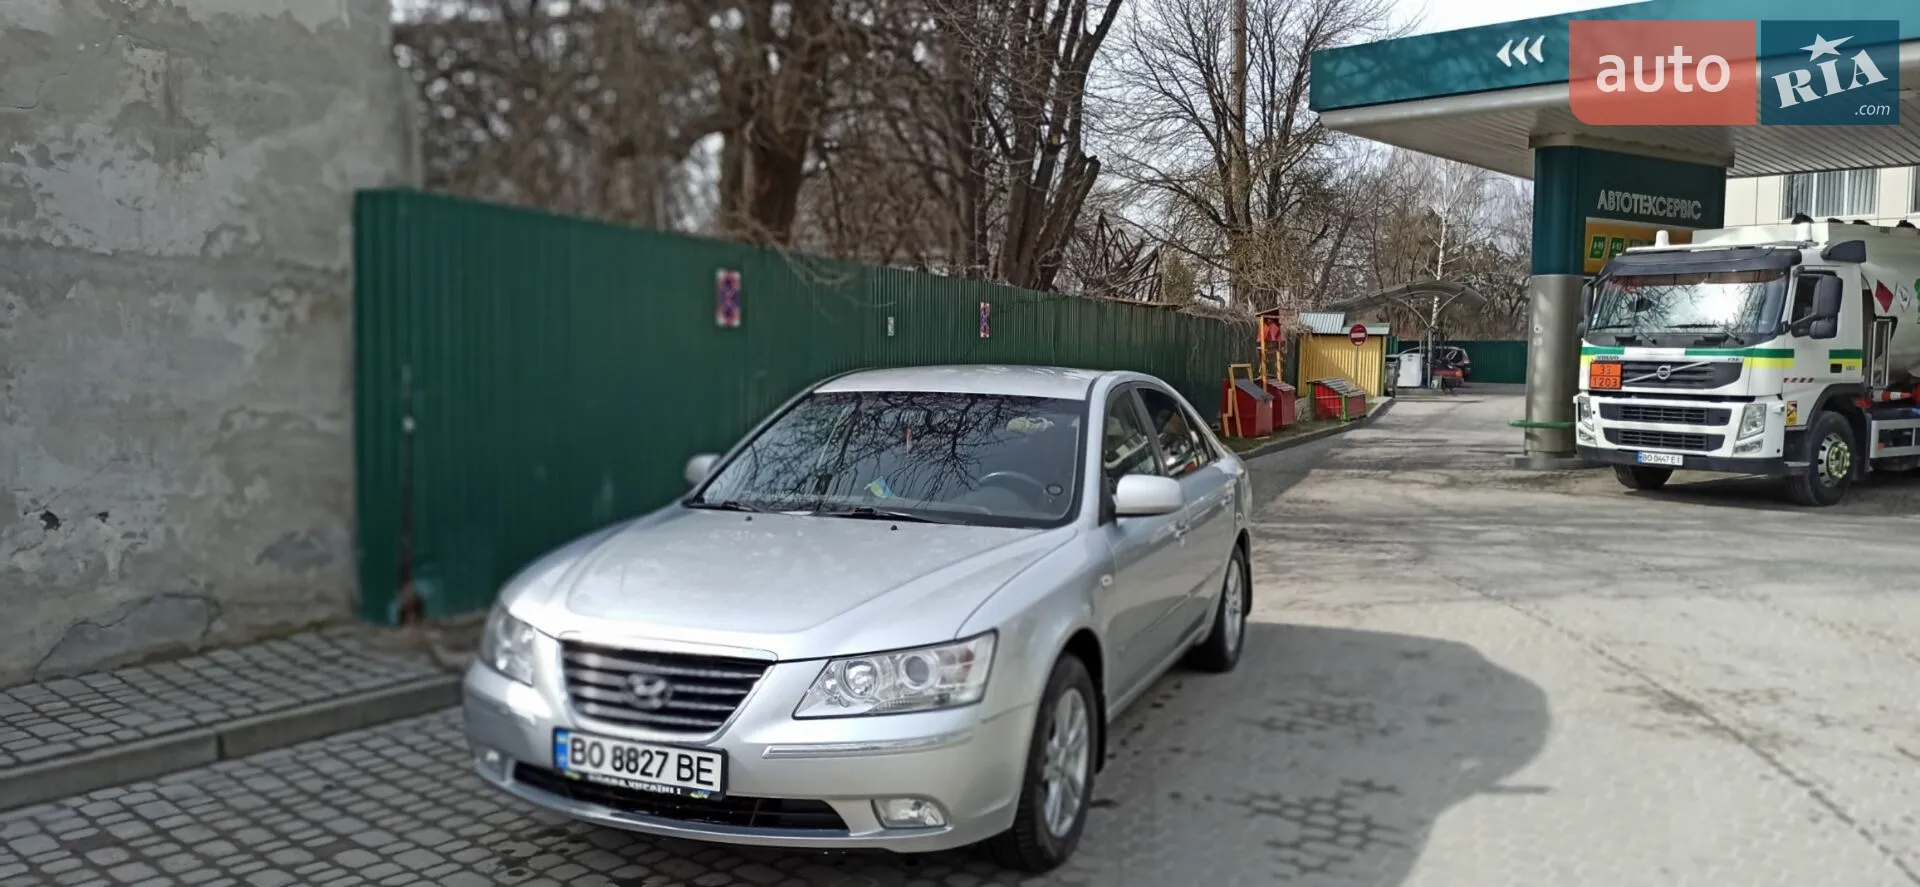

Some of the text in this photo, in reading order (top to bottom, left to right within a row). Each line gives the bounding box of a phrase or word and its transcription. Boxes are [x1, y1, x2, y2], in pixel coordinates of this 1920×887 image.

[1597, 189, 1702, 220] АВТОТЕХСЕРВІС
[1593, 377, 1618, 387] 1203
[570, 737, 605, 768] BO
[611, 745, 669, 779] 8827
[676, 754, 714, 786] BE
